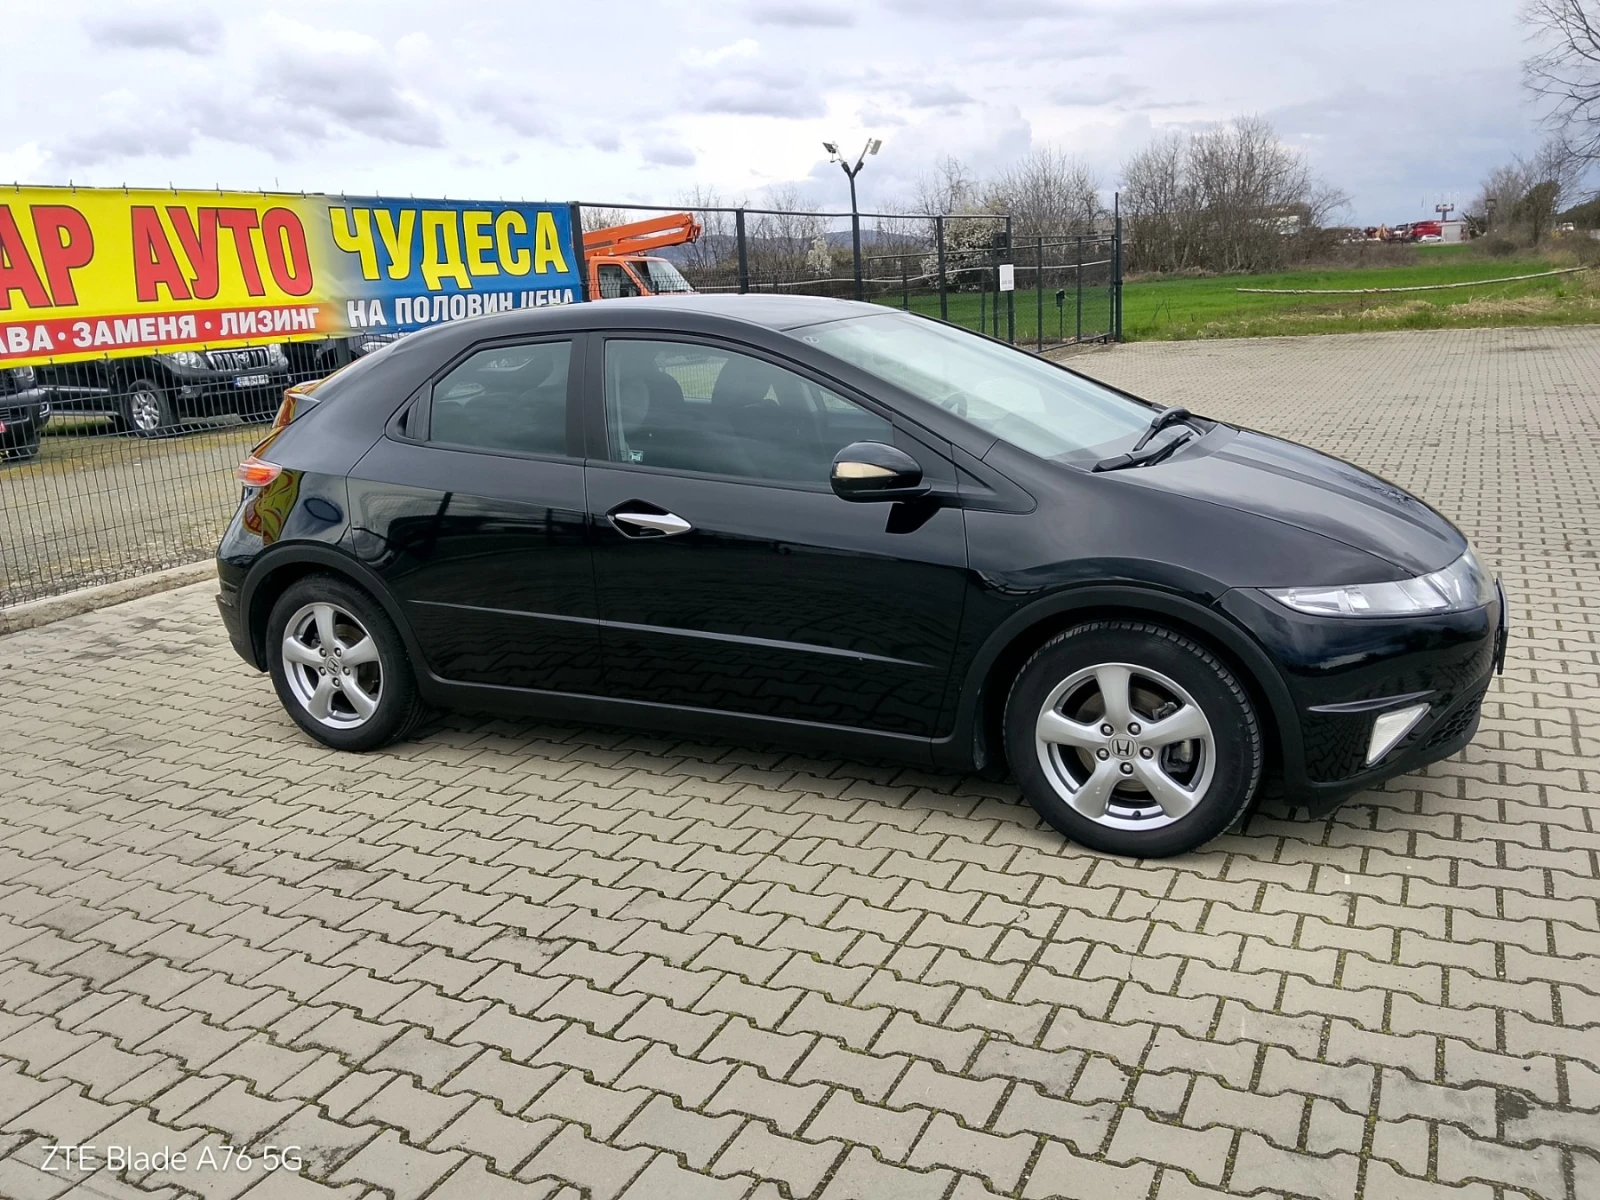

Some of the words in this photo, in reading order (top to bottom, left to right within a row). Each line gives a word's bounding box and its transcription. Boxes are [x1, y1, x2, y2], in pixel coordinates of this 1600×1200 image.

[130, 205, 313, 302] АУТО
[328, 206, 569, 291] ЧУДЕСА
[72, 315, 197, 348] ЗАМЕНЯ
[220, 308, 319, 336] ЛИЗИНГ
[347, 299, 388, 328] НА
[395, 292, 513, 325] ПОЛОВИН
